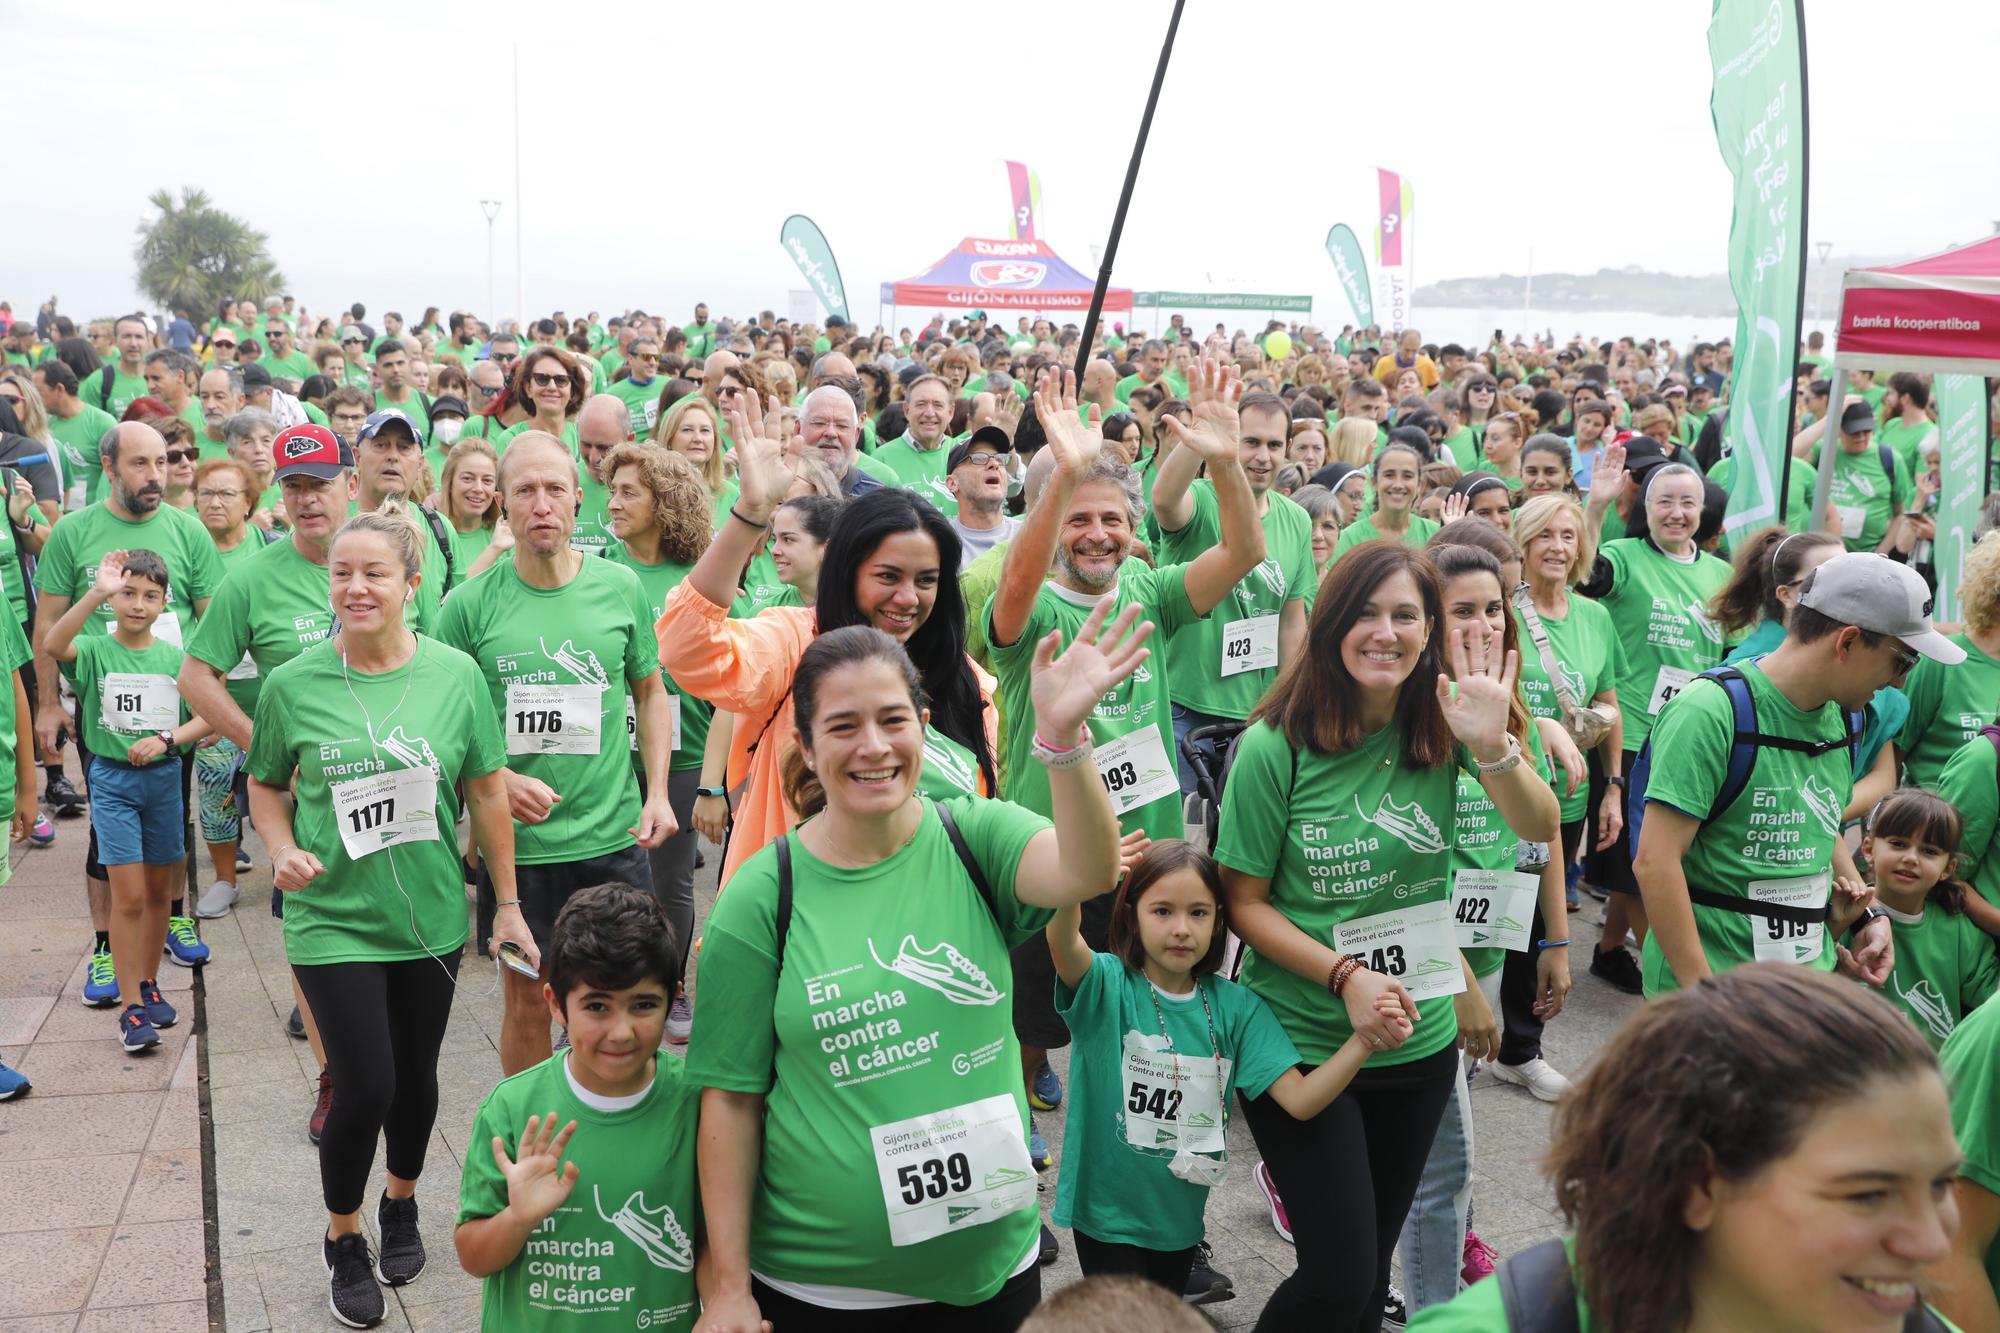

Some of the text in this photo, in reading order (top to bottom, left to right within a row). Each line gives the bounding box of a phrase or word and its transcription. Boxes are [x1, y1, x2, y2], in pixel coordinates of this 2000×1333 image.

[947, 290, 1082, 306] GIJÓN ATLETISMO
[1205, 295, 1243, 306] Española
[1853, 315, 1980, 331] banka kooperatiboa
[571, 535, 607, 543] marcha
[1235, 588, 1256, 601] ncer
[1652, 600, 1667, 611] En
[294, 618, 315, 631] En
[1650, 611, 1690, 625] marcha
[298, 629, 329, 643] mar
[1648, 622, 1684, 635] contra
[1227, 638, 1251, 659] 423
[1647, 632, 1696, 648] el cáncer
[496, 659, 517, 673] En
[500, 670, 557, 685] marcha
[1522, 680, 1550, 691] rcha
[115, 694, 142, 712] 151
[1530, 706, 1556, 716] ncer
[514, 711, 562, 734] 1176
[1960, 716, 1982, 728] En
[320, 746, 340, 760] En
[322, 758, 385, 776] marcha
[341, 794, 364, 805] contra
[373, 784, 397, 795] cáncer
[1752, 791, 1777, 808] En
[348, 798, 395, 833] 1177
[1456, 815, 1487, 828] ontra
[1750, 809, 1806, 825] marcha
[1302, 824, 1328, 842] En
[1458, 829, 1501, 844] cáncer
[1746, 829, 1800, 843] contra
[1303, 837, 1380, 860] marcha
[1742, 843, 1817, 861] el cáncer
[1307, 859, 1371, 877] contra
[1312, 879, 1327, 895] el
[1331, 869, 1397, 894] cáncer
[1756, 887, 1777, 896] Gijón
[1455, 898, 1490, 924] 422
[1340, 928, 1361, 939] Gijón
[1362, 925, 1373, 933] en
[1374, 919, 1404, 931] marcha
[1342, 927, 1405, 947] contra el cáncer
[807, 981, 841, 1006] En
[812, 990, 907, 1030] marcha
[820, 1018, 902, 1053] contra
[829, 1031, 939, 1078] el cáncer
[1130, 1054, 1150, 1067] Gijón
[1152, 1061, 1163, 1069] en
[1128, 1064, 1154, 1077] contra
[1156, 1070, 1165, 1079] el
[1128, 1082, 1183, 1121] 542
[883, 1131, 910, 1146] Gijón
[912, 1129, 926, 1139] en
[927, 1118, 965, 1136] marcha
[886, 1129, 968, 1157] contra el cáncer
[897, 1152, 972, 1206] 539
[527, 1238, 615, 1258] marcha
[528, 1261, 601, 1281] contra
[529, 1280, 636, 1304] el cáncer
